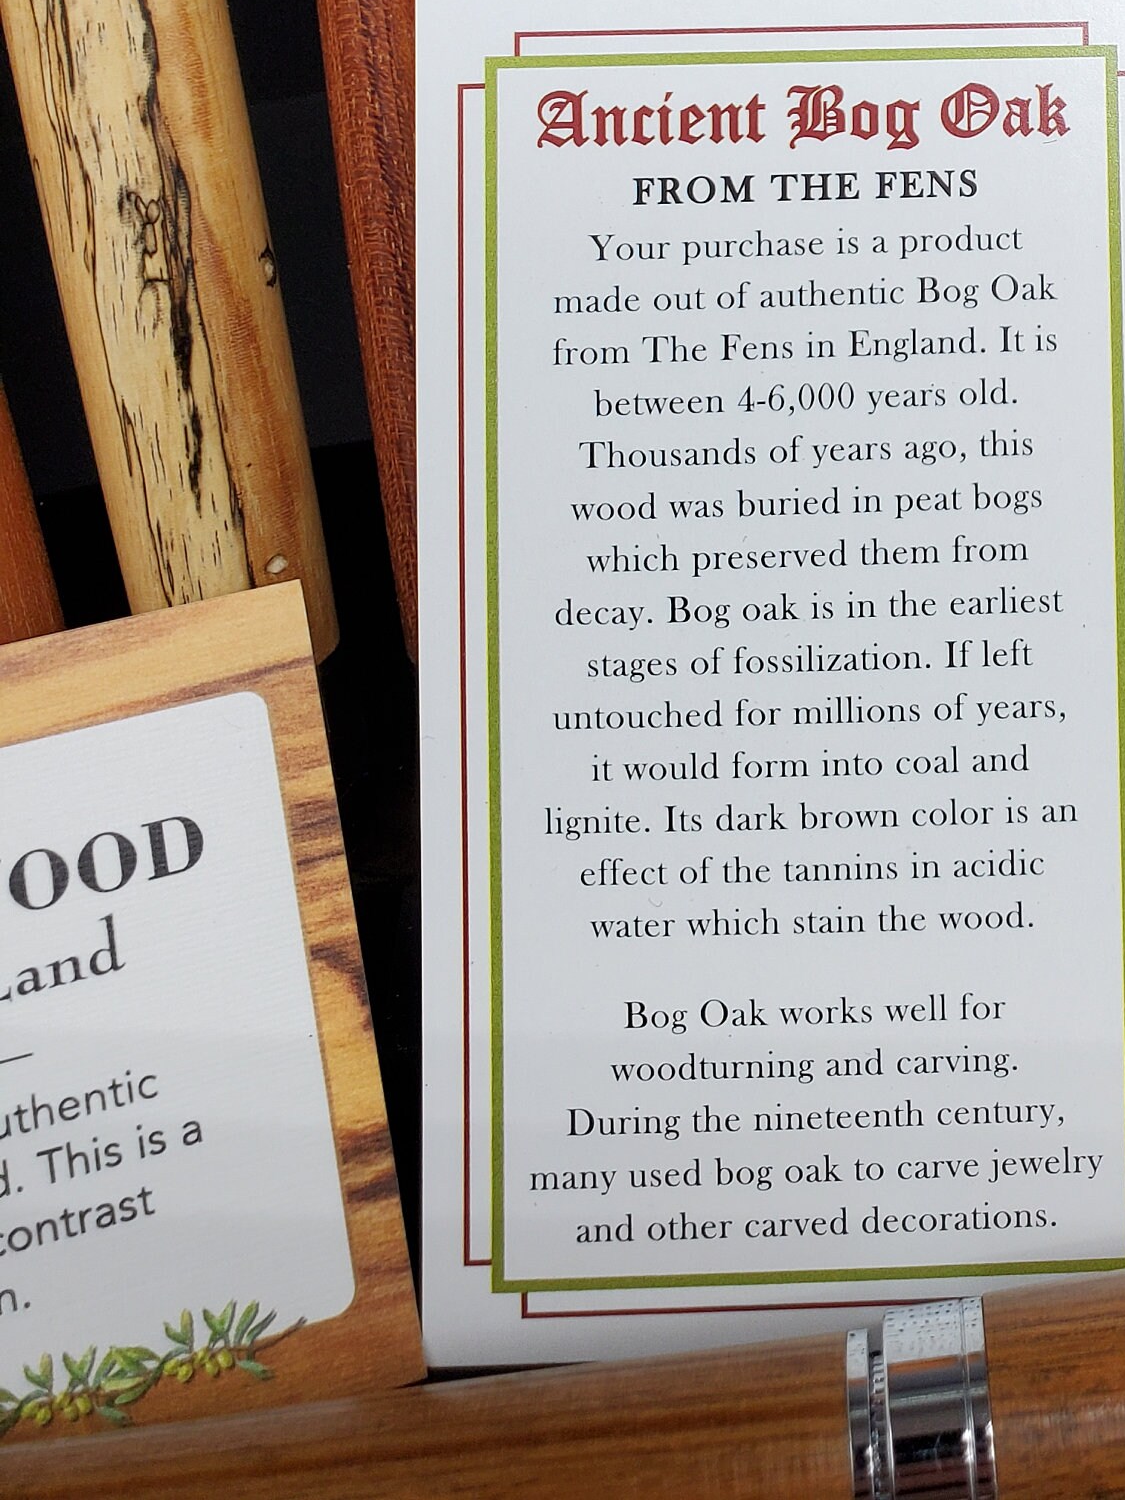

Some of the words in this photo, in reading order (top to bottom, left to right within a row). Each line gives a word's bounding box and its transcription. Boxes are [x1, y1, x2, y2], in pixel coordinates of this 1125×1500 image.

[537, 90, 767, 148] Ancient
[787, 84, 921, 151] Bog
[941, 83, 1071, 138] Oak
[632, 175, 755, 205] FROM
[770, 172, 860, 202] THE
[875, 169, 977, 199] FENS
[587, 234, 671, 261] Your
[681, 230, 824, 266] purchase
[836, 228, 859, 254] is
[872, 236, 889, 253] a
[899, 224, 1023, 260] product
[553, 285, 640, 314] made
[654, 288, 706, 311] out
[717, 281, 751, 309] of
[760, 278, 904, 308] authentic
[916, 276, 979, 309] Bog
[991, 273, 1058, 302] Oak
[552, 338, 631, 365] from
[642, 335, 707, 363] The
[720, 334, 793, 362] Fens
[806, 331, 837, 358] in
[848, 326, 986, 363] England.
[999, 325, 1025, 353] It
[1035, 325, 1057, 352] is
[593, 389, 725, 417] between
[737, 382, 854, 417] 4-6,000
[866, 383, 946, 415] years
[960, 377, 1017, 406] old.
[579, 437, 756, 468] Thousands
[770, 435, 804, 464] of
[811, 442, 891, 469] years
[905, 440, 966, 467] ago,
[979, 429, 1033, 457] this
[570, 492, 658, 521] wood
[668, 500, 723, 519] was
[736, 486, 841, 518] buried
[851, 486, 883, 513] in
[894, 488, 962, 519] peat
[971, 482, 1042, 515] bogs
[586, 544, 680, 573] which
[689, 539, 848, 577] preserved
[860, 538, 940, 565] them
[952, 534, 1029, 563] from
[555, 598, 653, 631] decay.
[664, 596, 731, 629] Bog
[742, 594, 799, 622] oak
[810, 592, 834, 620] is
[846, 591, 877, 619] in
[888, 589, 937, 617] the
[950, 586, 1064, 615] earliest
[588, 655, 677, 684] stages
[691, 647, 725, 675] of
[732, 642, 930, 674] fossilization.
[944, 640, 973, 668] If
[981, 638, 1033, 667] left
[552, 699, 724, 730] untouched
[734, 698, 781, 727] for
[792, 696, 920, 725] millions
[934, 692, 968, 721] of
[976, 700, 1065, 726] years,
[592, 754, 614, 781] it
[622, 752, 720, 781] would
[732, 751, 810, 779] form
[821, 749, 882, 777] into
[896, 745, 959, 775] coal
[972, 743, 1030, 772] and
[544, 806, 650, 841] lignite.
[664, 805, 702, 832] Its
[716, 803, 789, 832] dark
[798, 802, 900, 830] brown
[912, 798, 994, 828] color
[1005, 796, 1028, 824] is
[1042, 804, 1078, 823] an
[0, 816, 204, 910] OOD
[581, 858, 669, 886] effect
[680, 856, 713, 884] of
[722, 856, 771, 883] the
[784, 853, 898, 883] tannins
[910, 851, 941, 880] in
[954, 848, 1044, 878] acidic
[590, 916, 675, 939] water
[686, 907, 781, 936] which
[793, 906, 866, 934] stain
[878, 904, 926, 932] the
[937, 901, 1033, 930] wood.
[624, 1001, 688, 1035] Bog
[701, 998, 769, 1028] Oak
[778, 996, 872, 1025] works
[883, 993, 948, 1022] well
[960, 992, 1006, 1020] for
[610, 1051, 816, 1085] woodturning
[826, 1048, 884, 1077] and
[897, 1045, 1017, 1078] carving.
[566, 1105, 681, 1141] During
[692, 1103, 742, 1134] the
[752, 1099, 925, 1132] nineteenth
[937, 1100, 1065, 1129] century,
[36, 1137, 122, 1183] This
[136, 1124, 167, 1159] is
[182, 1120, 203, 1146] a
[530, 1171, 617, 1195] many
[628, 1158, 703, 1188] used
[714, 1157, 773, 1191] bog
[785, 1154, 844, 1183] oak
[854, 1158, 884, 1181] to
[898, 1159, 979, 1180] carve
[988, 1146, 1104, 1183] jewelry
[0, 1186, 156, 1256] ontrast
[576, 1213, 635, 1243] and
[648, 1212, 733, 1241] other
[745, 1206, 849, 1238] carved
[862, 1202, 1056, 1235] decorations.
